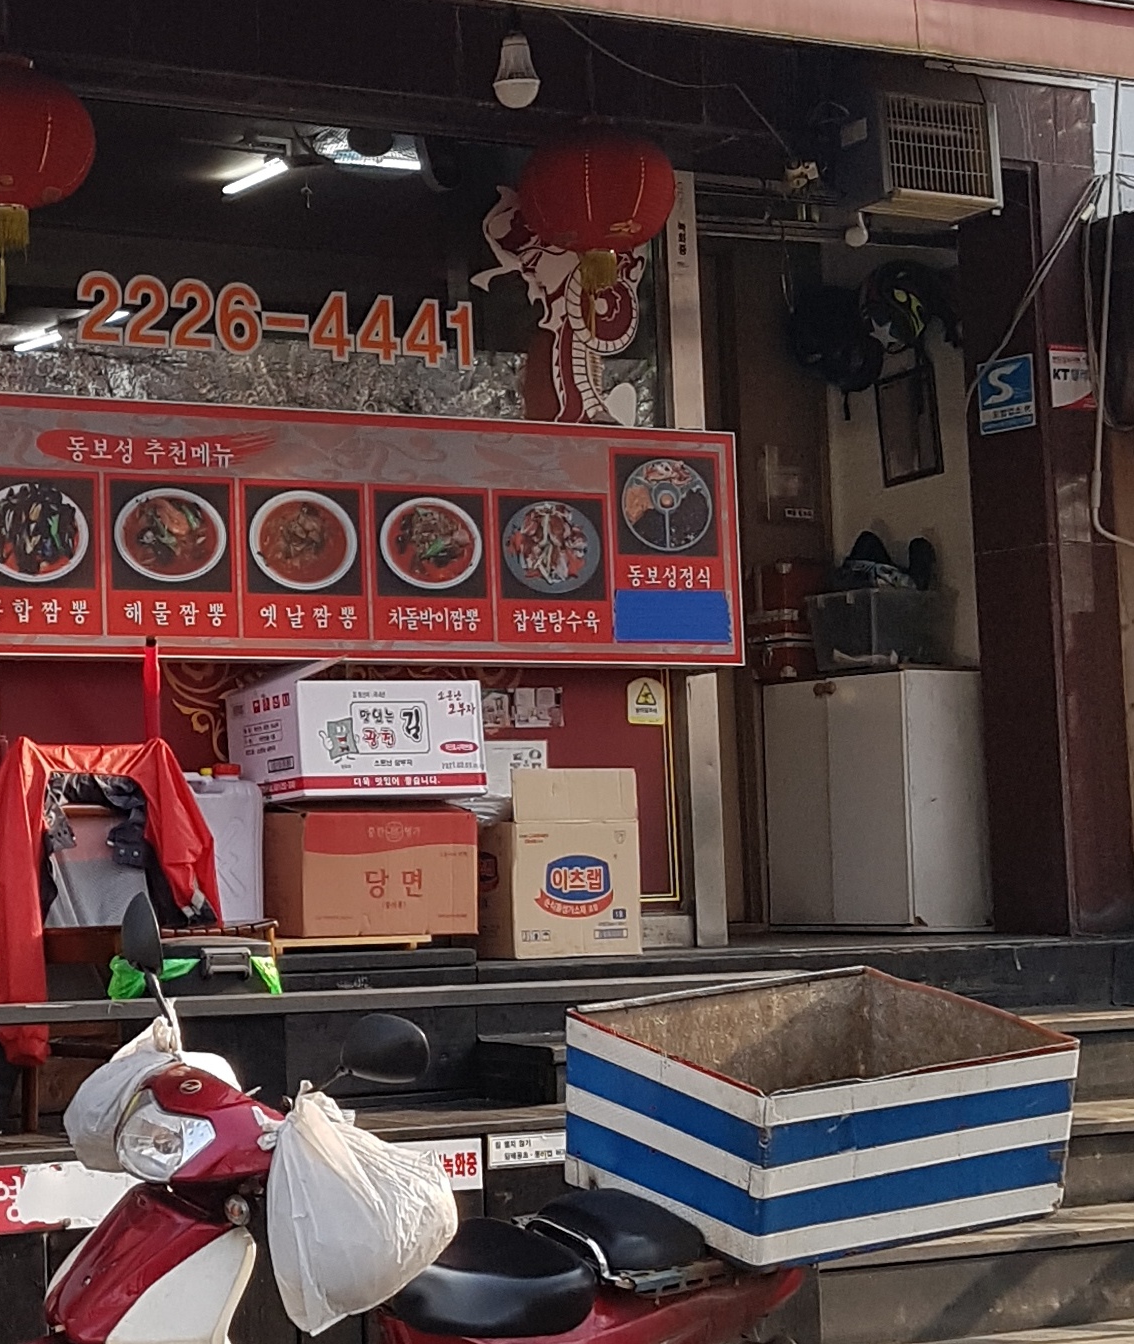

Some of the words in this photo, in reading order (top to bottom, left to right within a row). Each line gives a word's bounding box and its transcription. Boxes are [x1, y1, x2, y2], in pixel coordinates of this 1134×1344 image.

[77, 271, 474, 371] 2226-4441
[66, 435, 133, 462] 동보성
[144, 439, 234, 468] 추천메뉴
[627, 564, 712, 589] 동보성정식
[260, 602, 358, 630] 옛날짬뽕
[388, 606, 481, 633] 차돌박이짬뽕
[513, 609, 601, 634] 찹쌀탕수육
[359, 707, 395, 725] 맛있는
[401, 707, 421, 740] 김
[552, 869, 602, 891] 이츠랩
